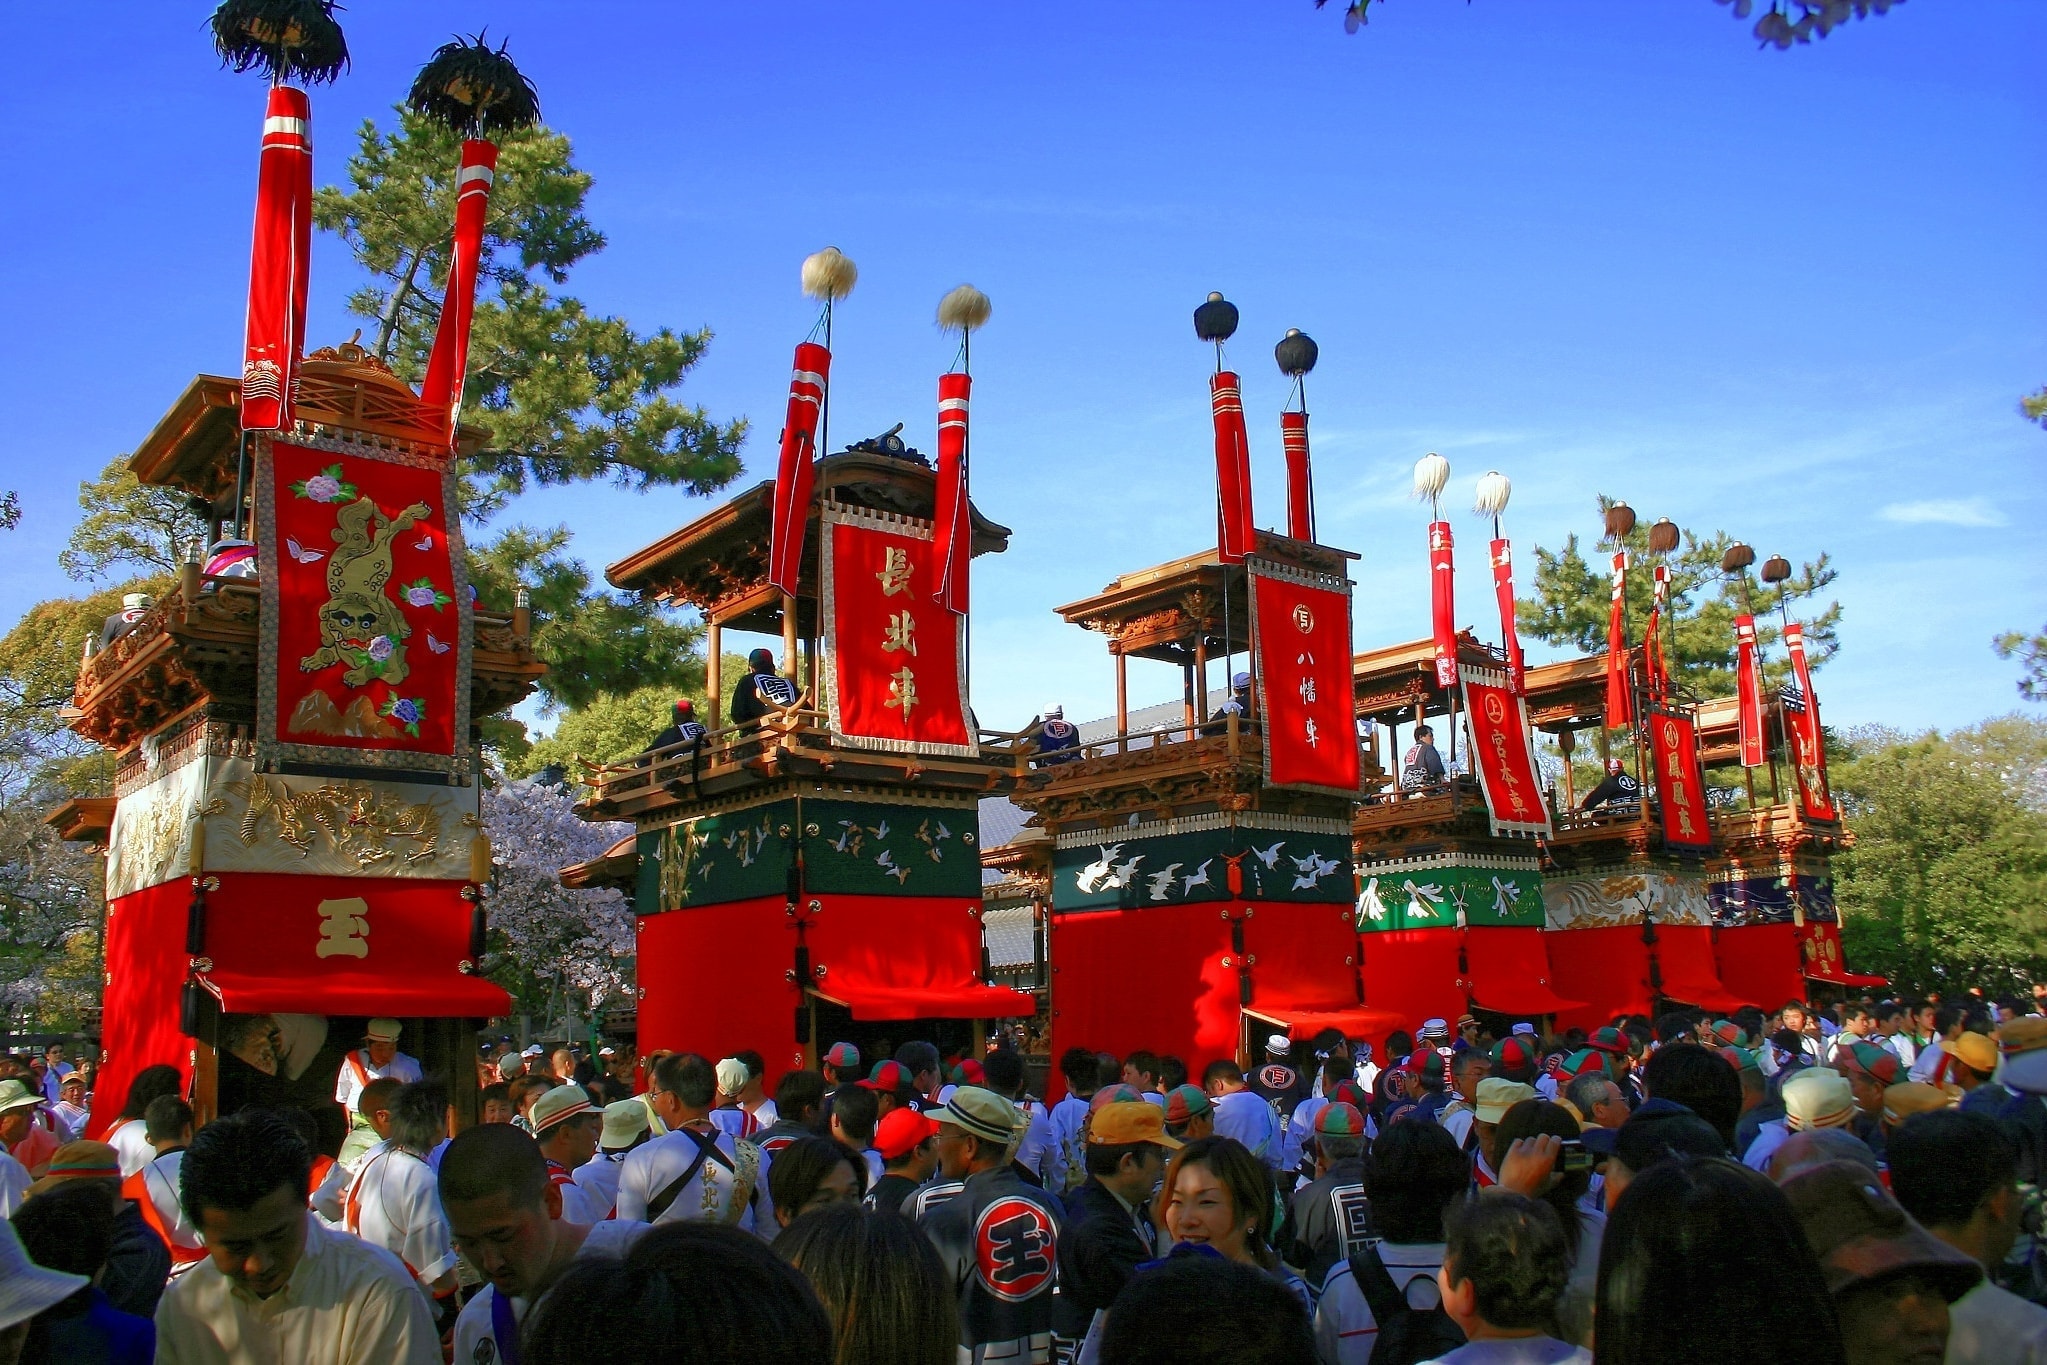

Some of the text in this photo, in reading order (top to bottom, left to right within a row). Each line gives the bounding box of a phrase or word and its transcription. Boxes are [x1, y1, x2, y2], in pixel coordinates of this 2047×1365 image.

[875, 546, 920, 726] 長北車
[1297, 651, 1320, 749] 八幡車
[316, 897, 370, 959] 玉
[987, 1211, 1051, 1285] 玉
